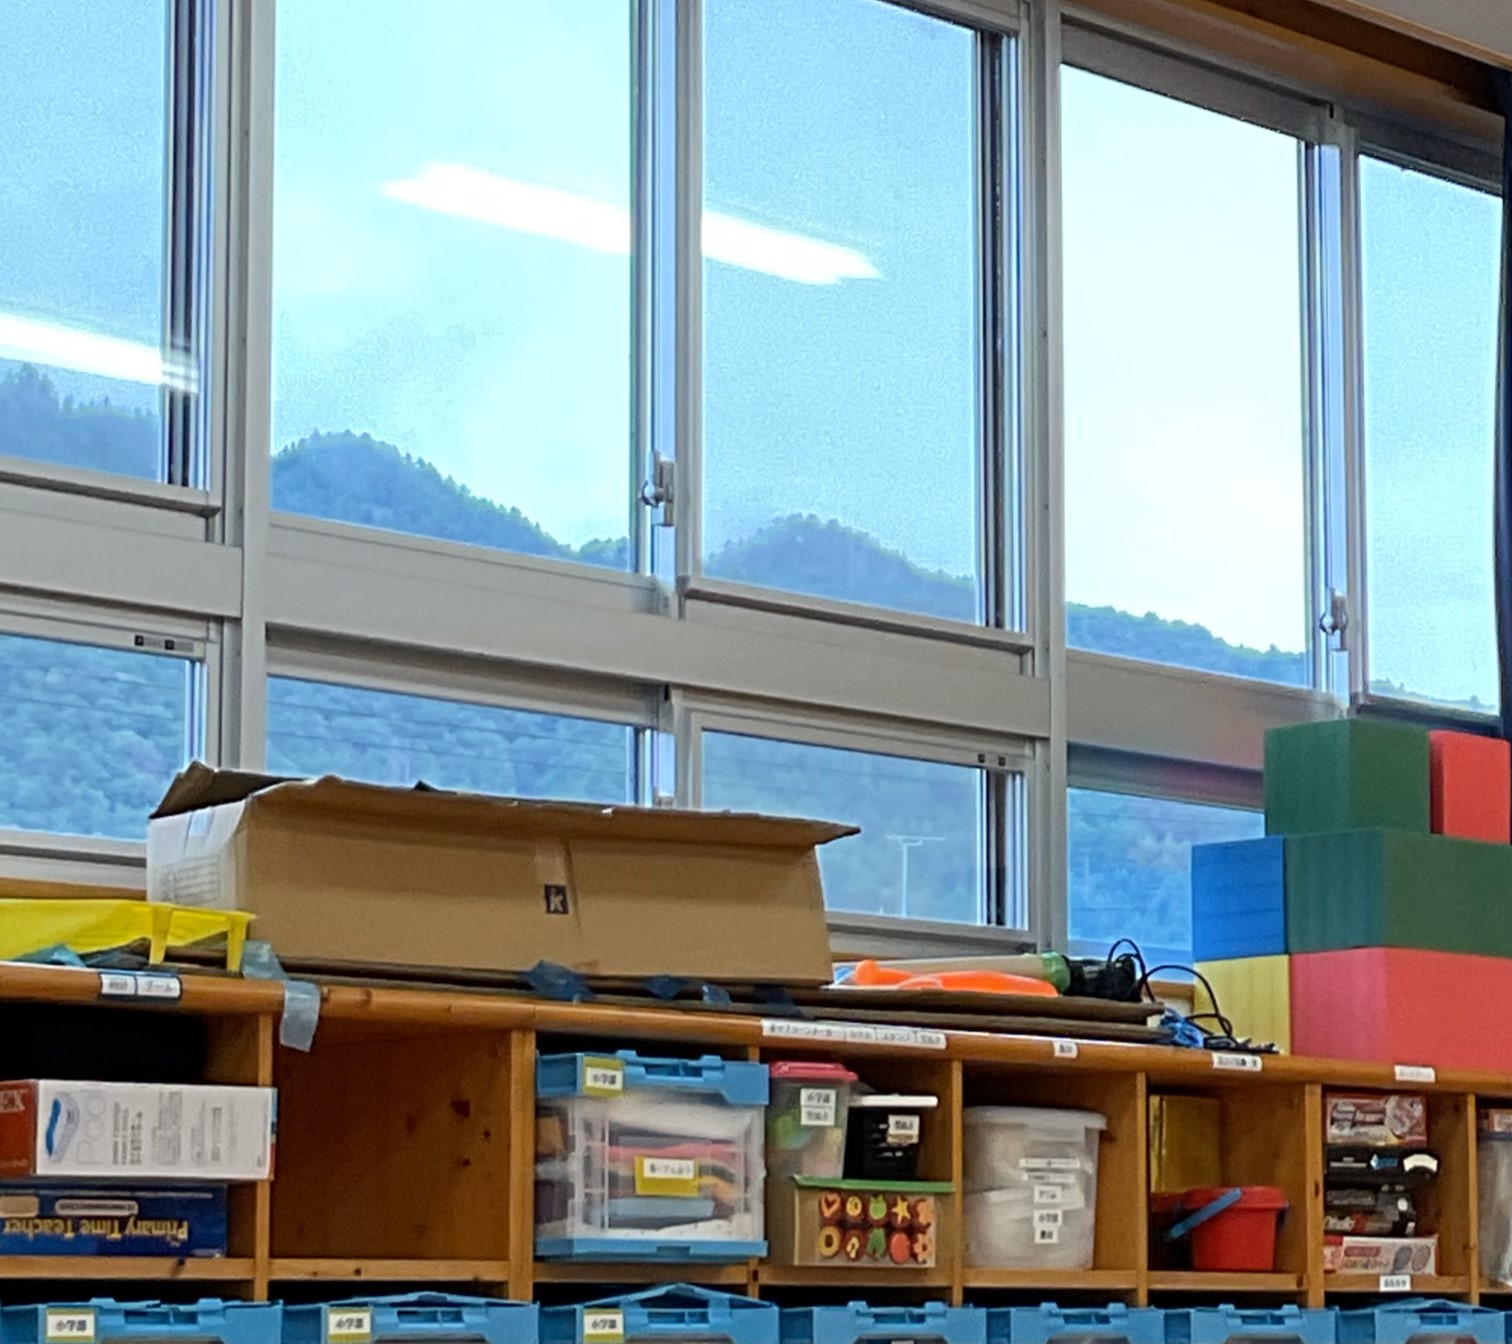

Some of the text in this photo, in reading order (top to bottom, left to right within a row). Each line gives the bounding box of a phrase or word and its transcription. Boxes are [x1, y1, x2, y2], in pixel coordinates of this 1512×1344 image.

[3, 1216, 189, 1241] Primary Time Teacher
